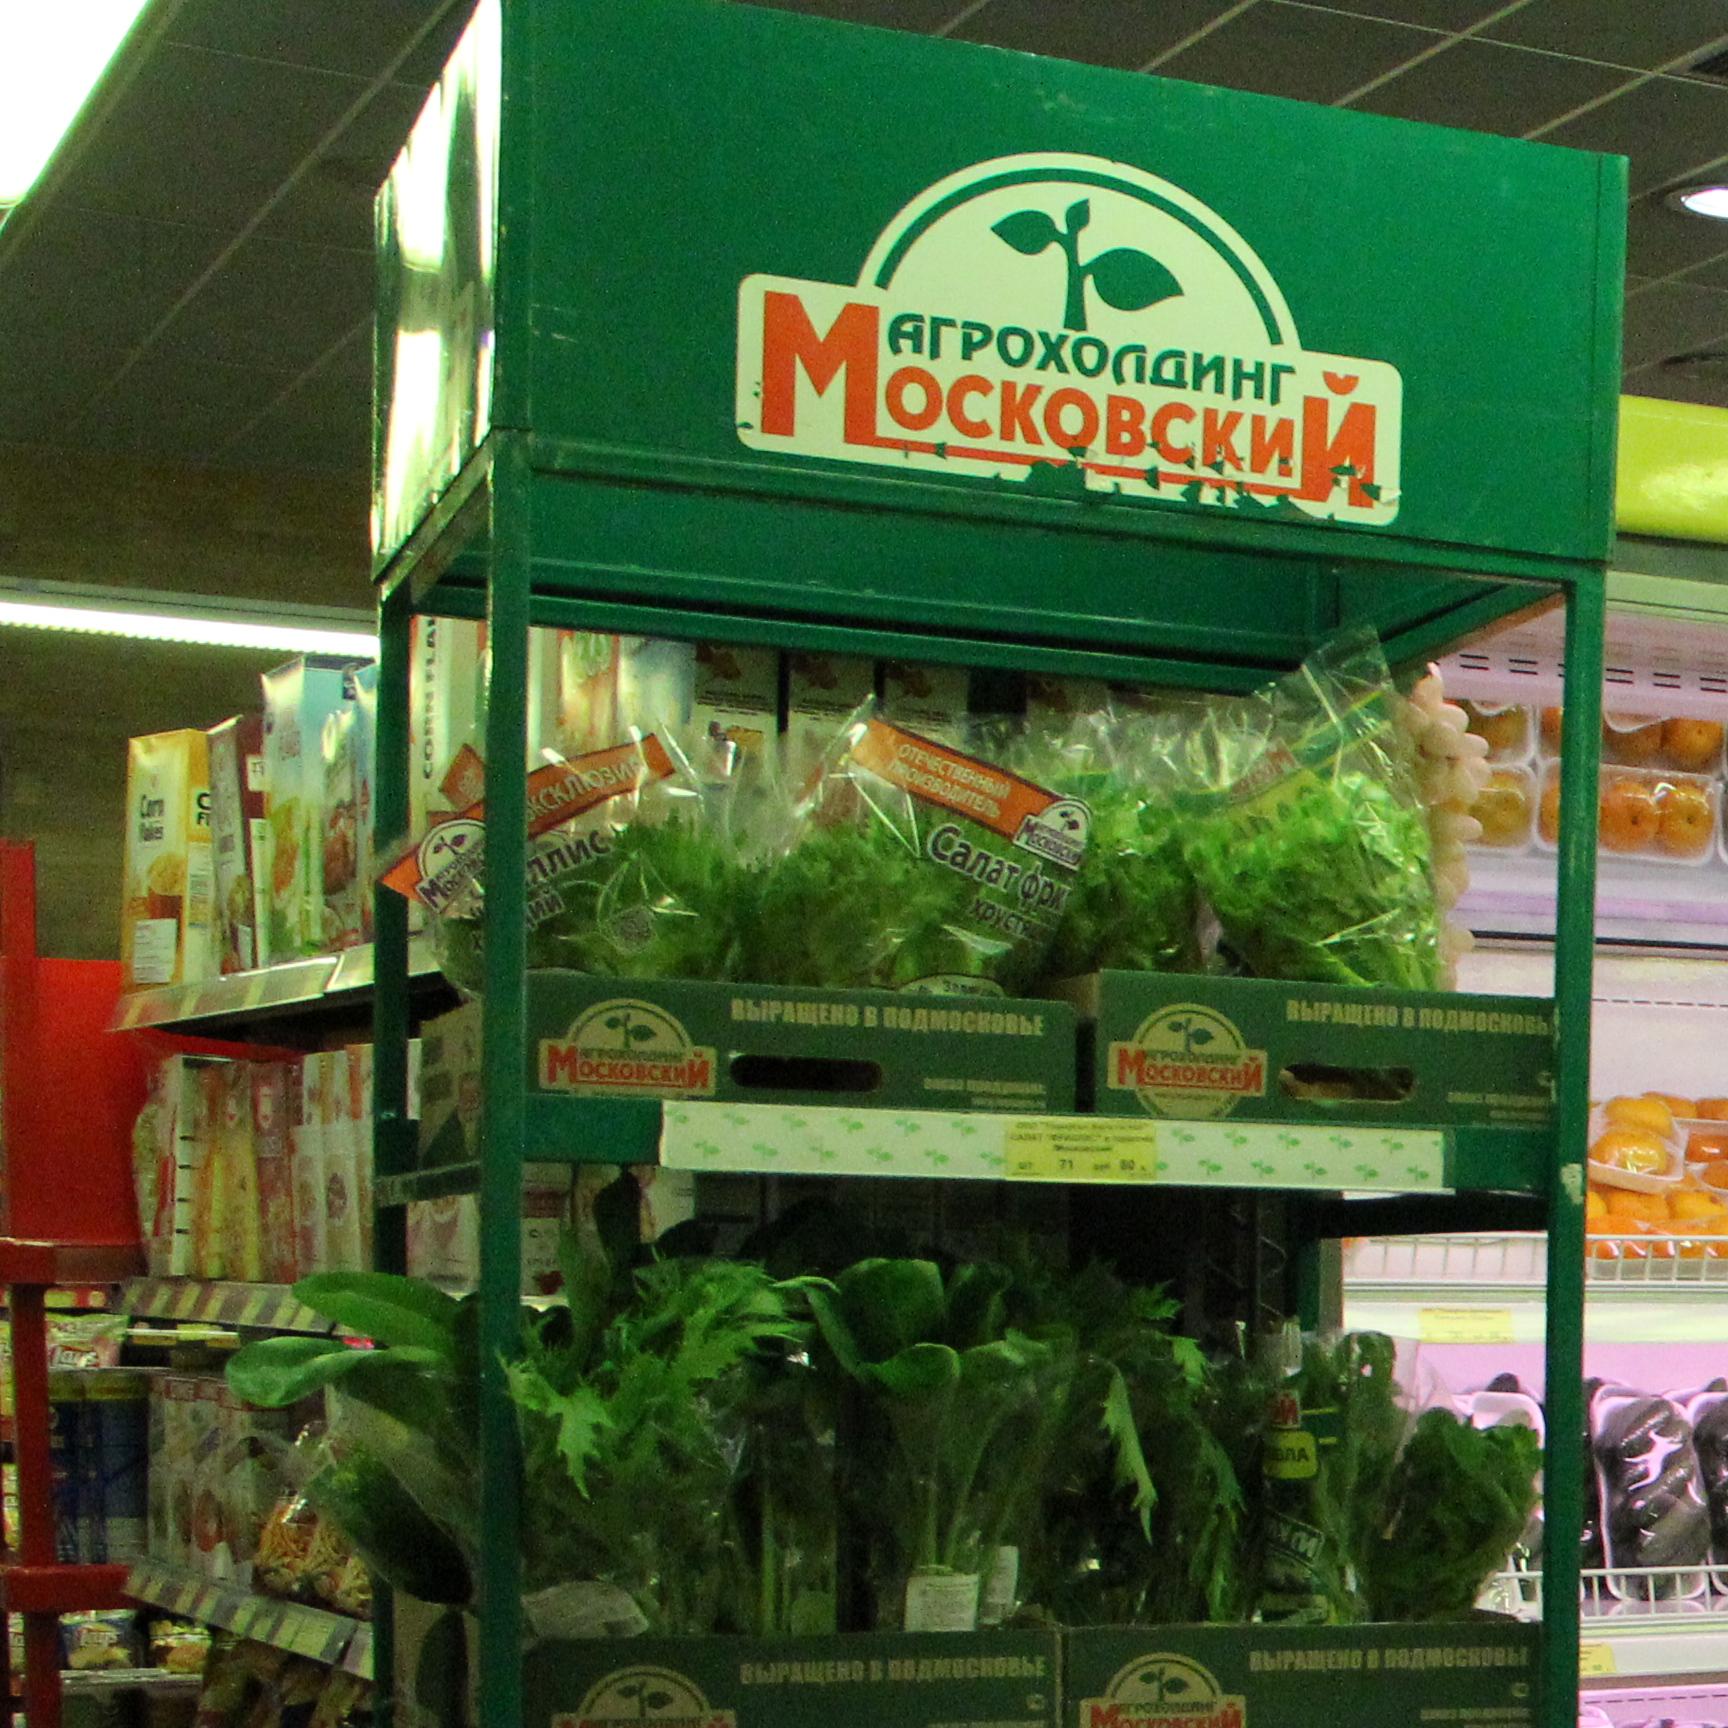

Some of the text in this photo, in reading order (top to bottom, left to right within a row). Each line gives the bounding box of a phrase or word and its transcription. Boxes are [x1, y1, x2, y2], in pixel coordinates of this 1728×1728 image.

[760, 290, 1378, 509] МОСКОВСКИЙ
[888, 312, 1296, 407] АГРОХОЛДИНГ
[927, 822, 1022, 894] Салат
